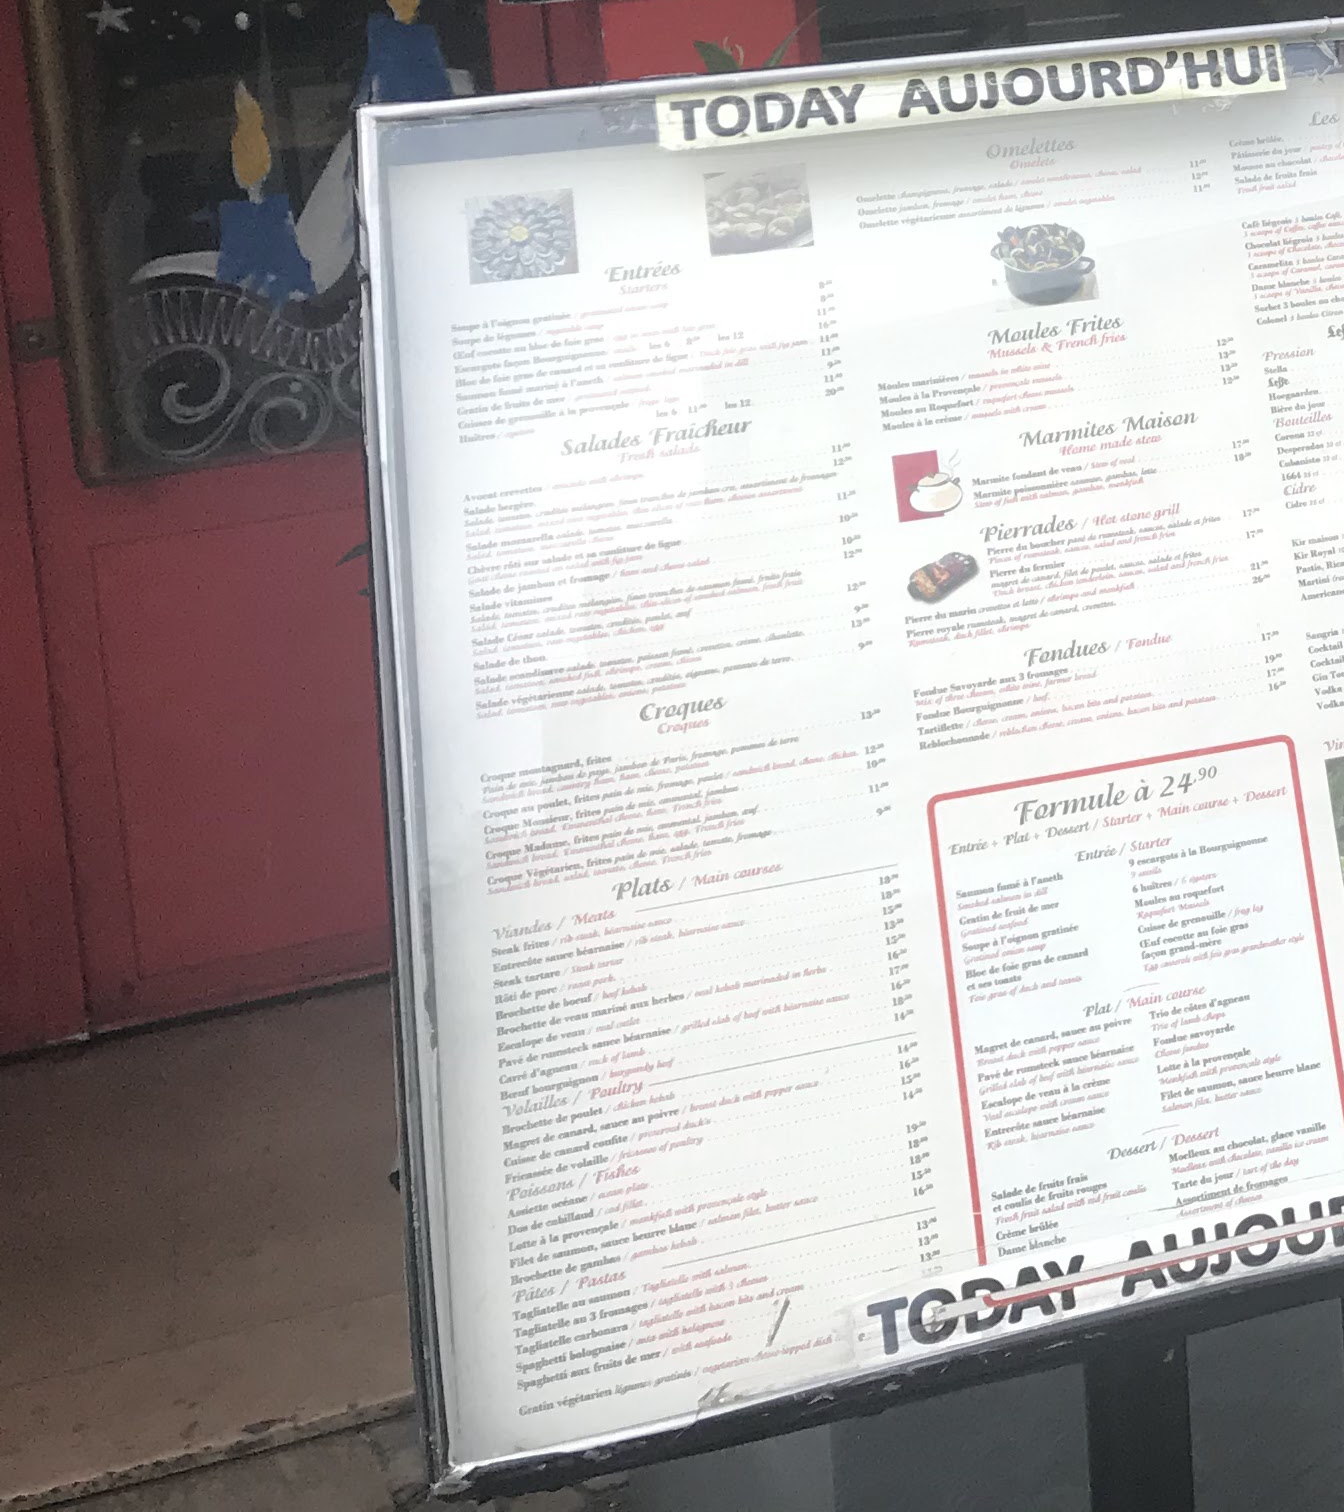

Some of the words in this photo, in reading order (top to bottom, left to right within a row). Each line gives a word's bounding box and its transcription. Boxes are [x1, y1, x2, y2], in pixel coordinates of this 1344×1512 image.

[670, 81, 865, 142] TODAY
[897, 43, 1284, 118] AUJOURD'HUI
[985, 137, 1075, 160] Omelettes
[604, 260, 684, 284] Entrées
[987, 323, 1061, 346] Moules
[1065, 314, 1125, 335] Frites
[1263, 346, 1316, 362] Pression
[1018, 421, 1117, 447] Marmites
[1122, 410, 1199, 432] Maison
[1273, 412, 1333, 429] Bouteilles
[560, 430, 641, 458] Salades
[1283, 482, 1317, 496] Cidre
[979, 514, 1078, 543] Pierrades
[1023, 638, 1111, 667] Fondues
[638, 695, 727, 723] Croques
[1014, 783, 1130, 826] Formule
[1134, 776, 1154, 801] à
[948, 838, 989, 856] Entrée
[1003, 829, 1031, 847] Plat
[1044, 819, 1091, 839] Dessert
[1102, 811, 1144, 829] Starter
[1157, 801, 1192, 819] Main
[1243, 786, 1288, 804] Dessert
[1075, 845, 1118, 863] Entrée
[1129, 834, 1173, 852] Starter
[612, 877, 674, 902] Plats
[1083, 1000, 1113, 1020] Plat
[1126, 992, 1164, 1011] Main
[501, 1093, 569, 1118] Volailles
[1107, 1138, 1160, 1161] Dessert
[1171, 1126, 1220, 1147] Dessert
[506, 1176, 574, 1201] Poissons
[867, 1254, 1085, 1356] TODAY
